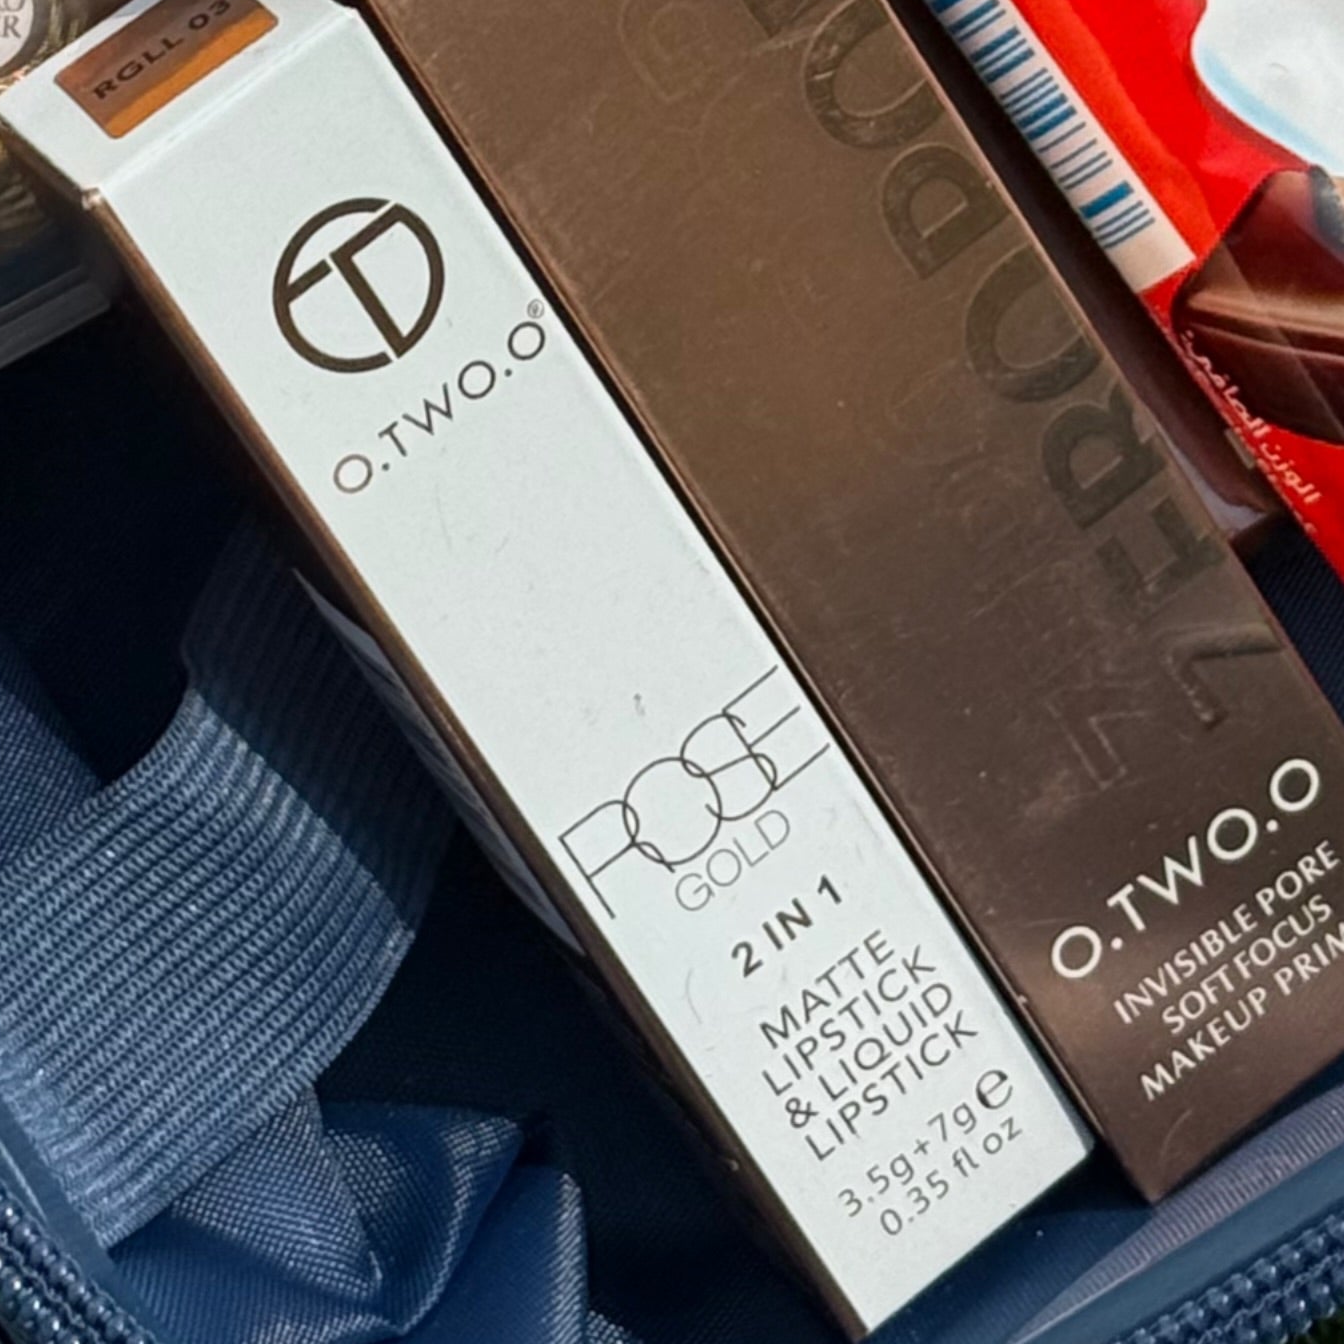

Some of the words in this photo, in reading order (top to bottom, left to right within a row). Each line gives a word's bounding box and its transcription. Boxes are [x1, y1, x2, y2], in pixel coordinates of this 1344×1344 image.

[92, 30, 185, 102] RGLL
[674, 808, 792, 914] GOLD
[731, 941, 763, 978] 2
[762, 898, 813, 951] IN
[817, 875, 842, 905] 1
[1050, 758, 1320, 981] O.TWO.O
[759, 929, 896, 1049] MATTE
[1112, 906, 1256, 1026] INVISIBLE
[1256, 839, 1340, 913] PORE
[1159, 972, 1236, 1037] SOFT
[1224, 894, 1334, 979] FOCUS
[761, 944, 936, 1096] LIPSTICK
[784, 1097, 819, 1129] &
[817, 983, 953, 1101] LIQUID
[804, 1009, 979, 1162] LIPSTICK
[1140, 994, 1270, 1102] MAKEUP
[879, 1169, 950, 1236] 0.35
[981, 1115, 1024, 1156] oz
